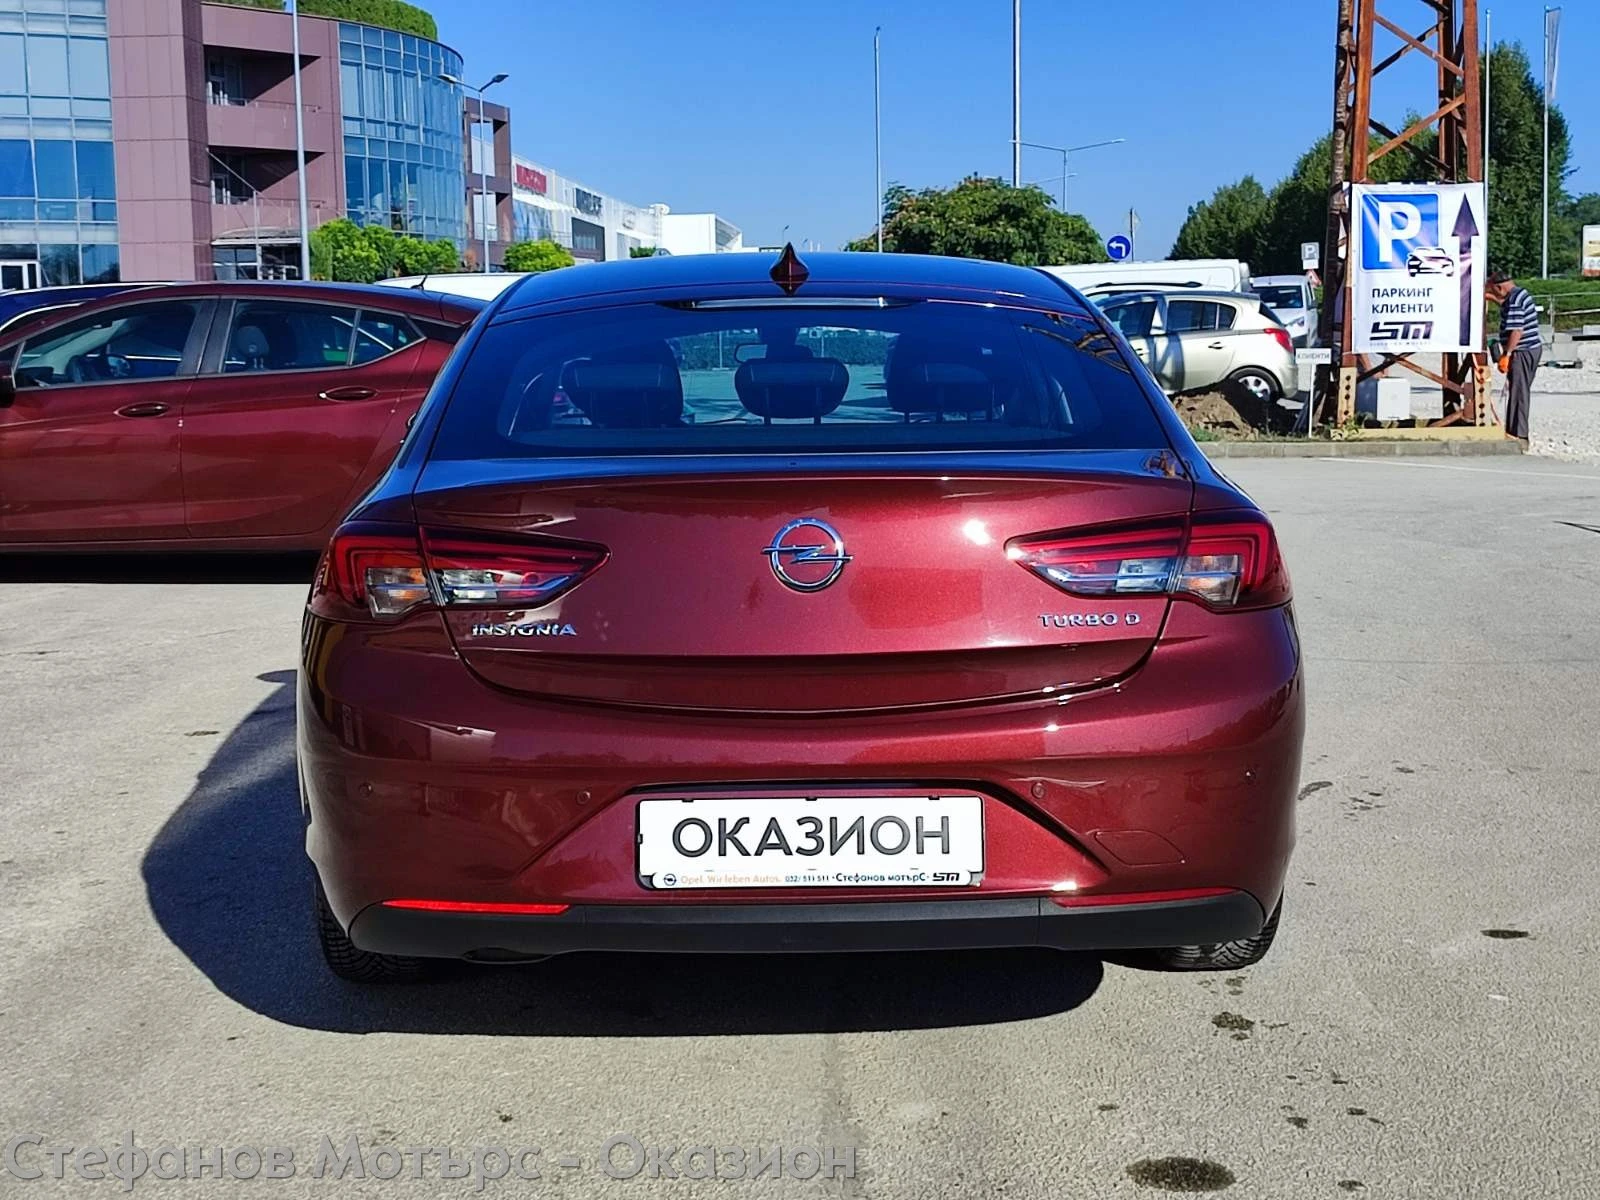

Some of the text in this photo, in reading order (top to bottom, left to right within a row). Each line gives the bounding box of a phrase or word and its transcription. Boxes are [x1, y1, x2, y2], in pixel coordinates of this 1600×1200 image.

[1378, 201, 1422, 262] P
[1304, 245, 1316, 259] P
[1371, 288, 1433, 298] ПАРКИНГ
[1371, 303, 1434, 313] КЛИЕНТИ
[1038, 612, 1140, 627] TURBO D
[472, 623, 577, 636] INSIGNIA
[672, 815, 951, 858] ОКАЗИОН
